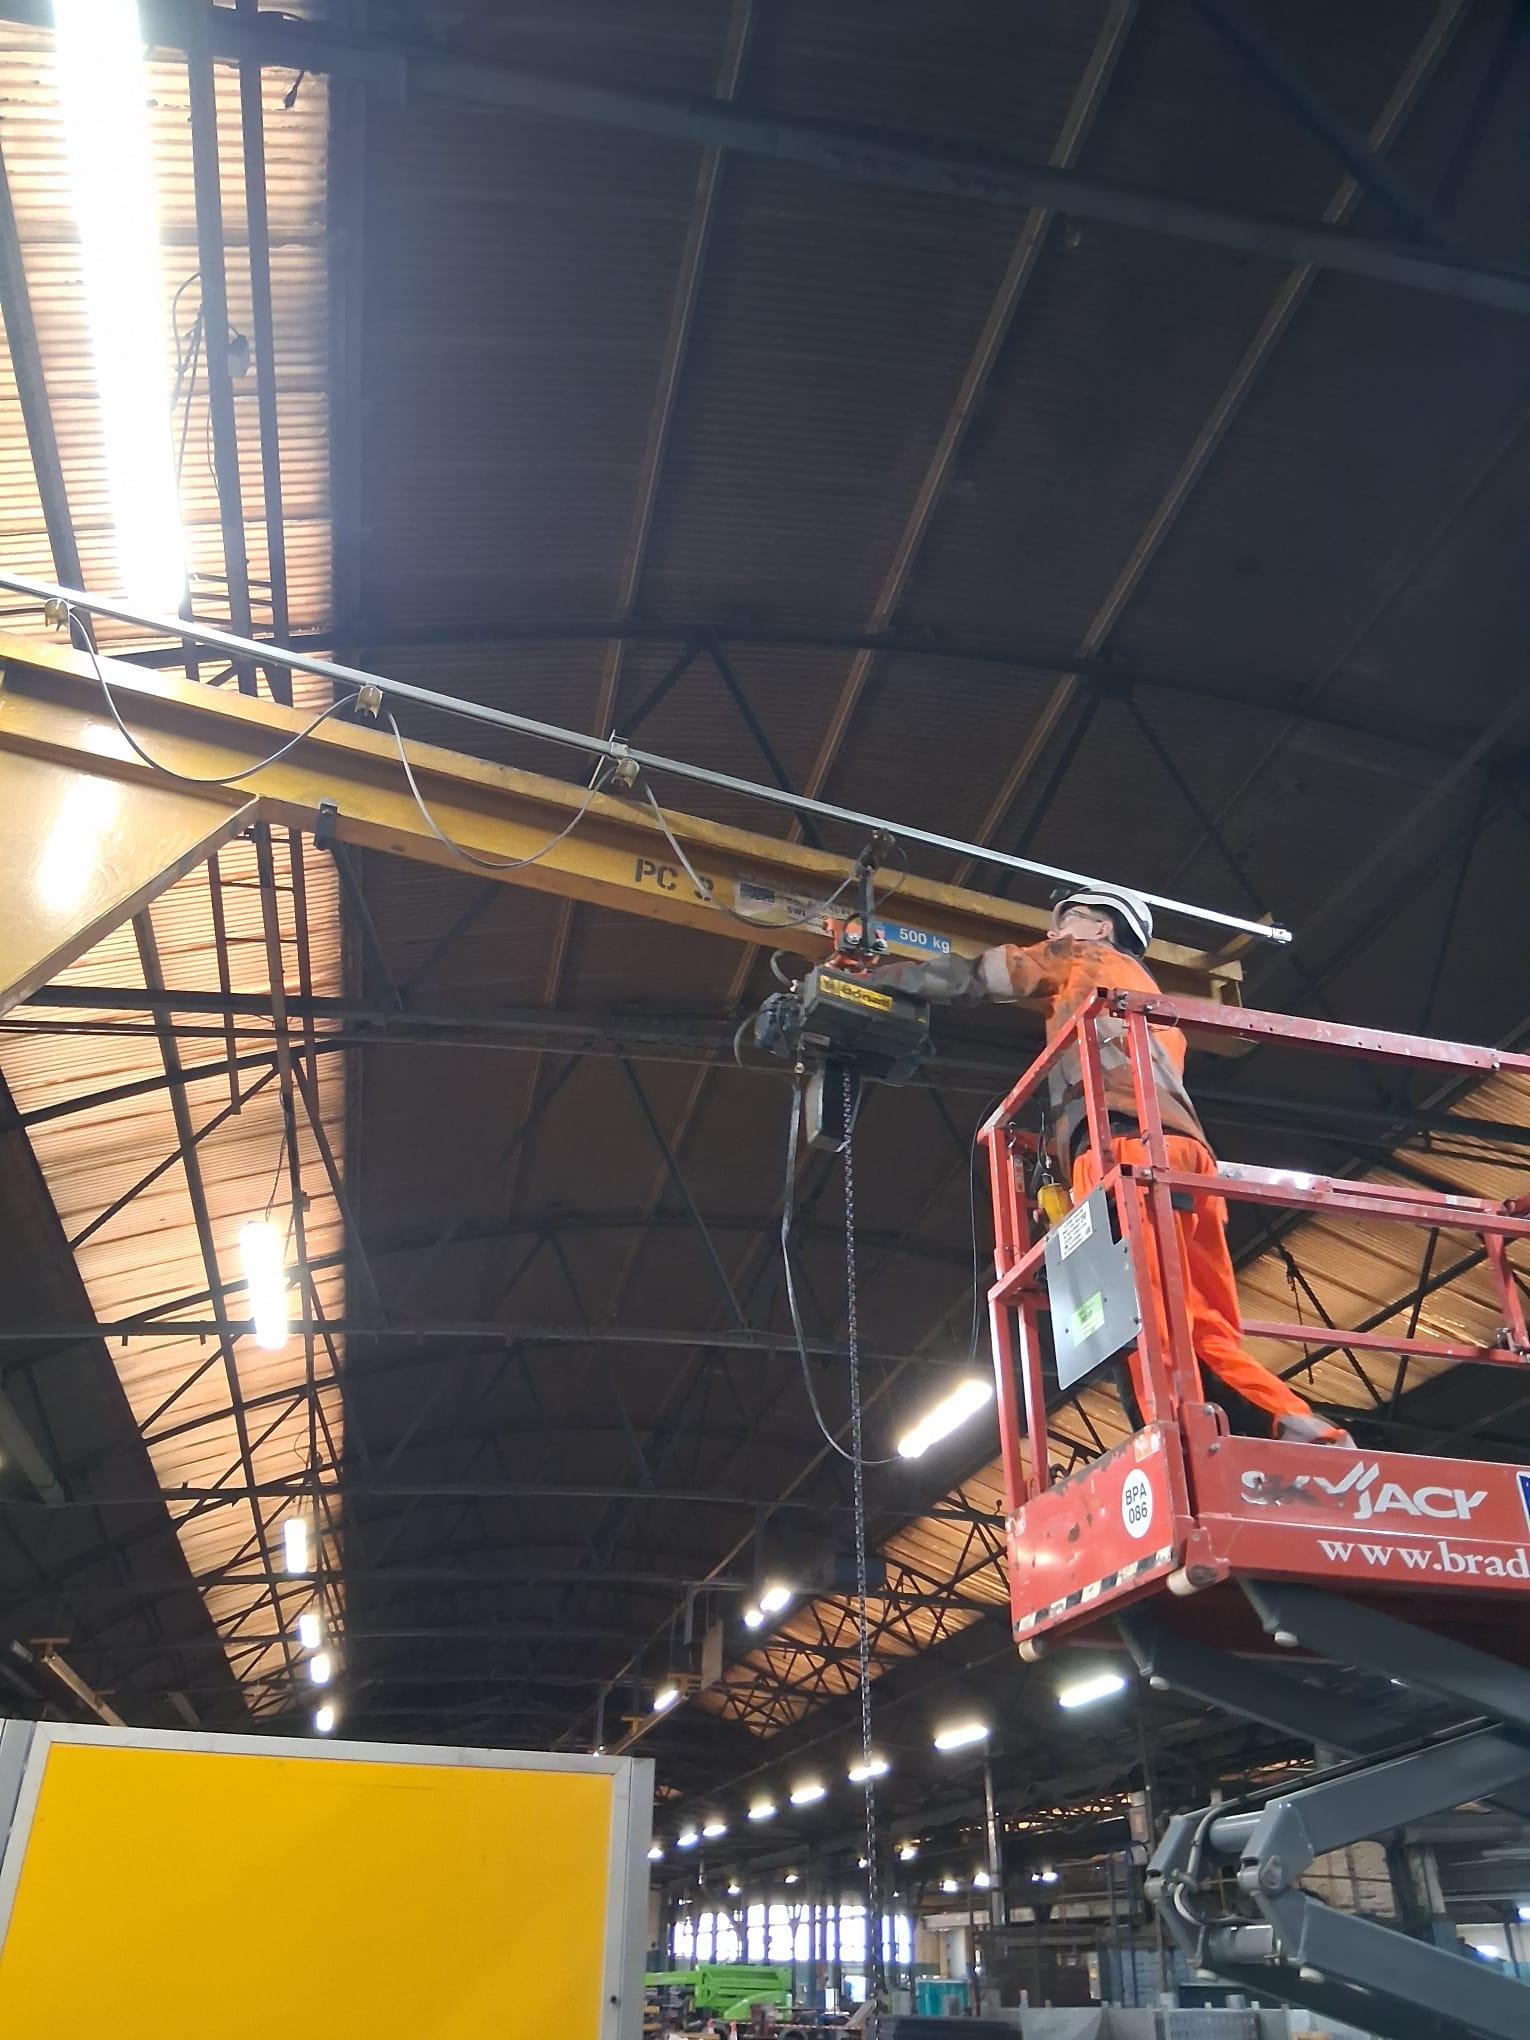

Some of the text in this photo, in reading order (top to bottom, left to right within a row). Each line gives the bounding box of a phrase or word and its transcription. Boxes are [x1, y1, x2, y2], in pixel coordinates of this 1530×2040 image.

[635, 858, 678, 891] PC
[899, 927, 950, 954] 500 kg
[1125, 1482, 1147, 1506] BPA
[1240, 1461, 1489, 1520] SYJACK
[1128, 1501, 1148, 1524] 086
[1317, 1539, 1530, 1580] www.brad
